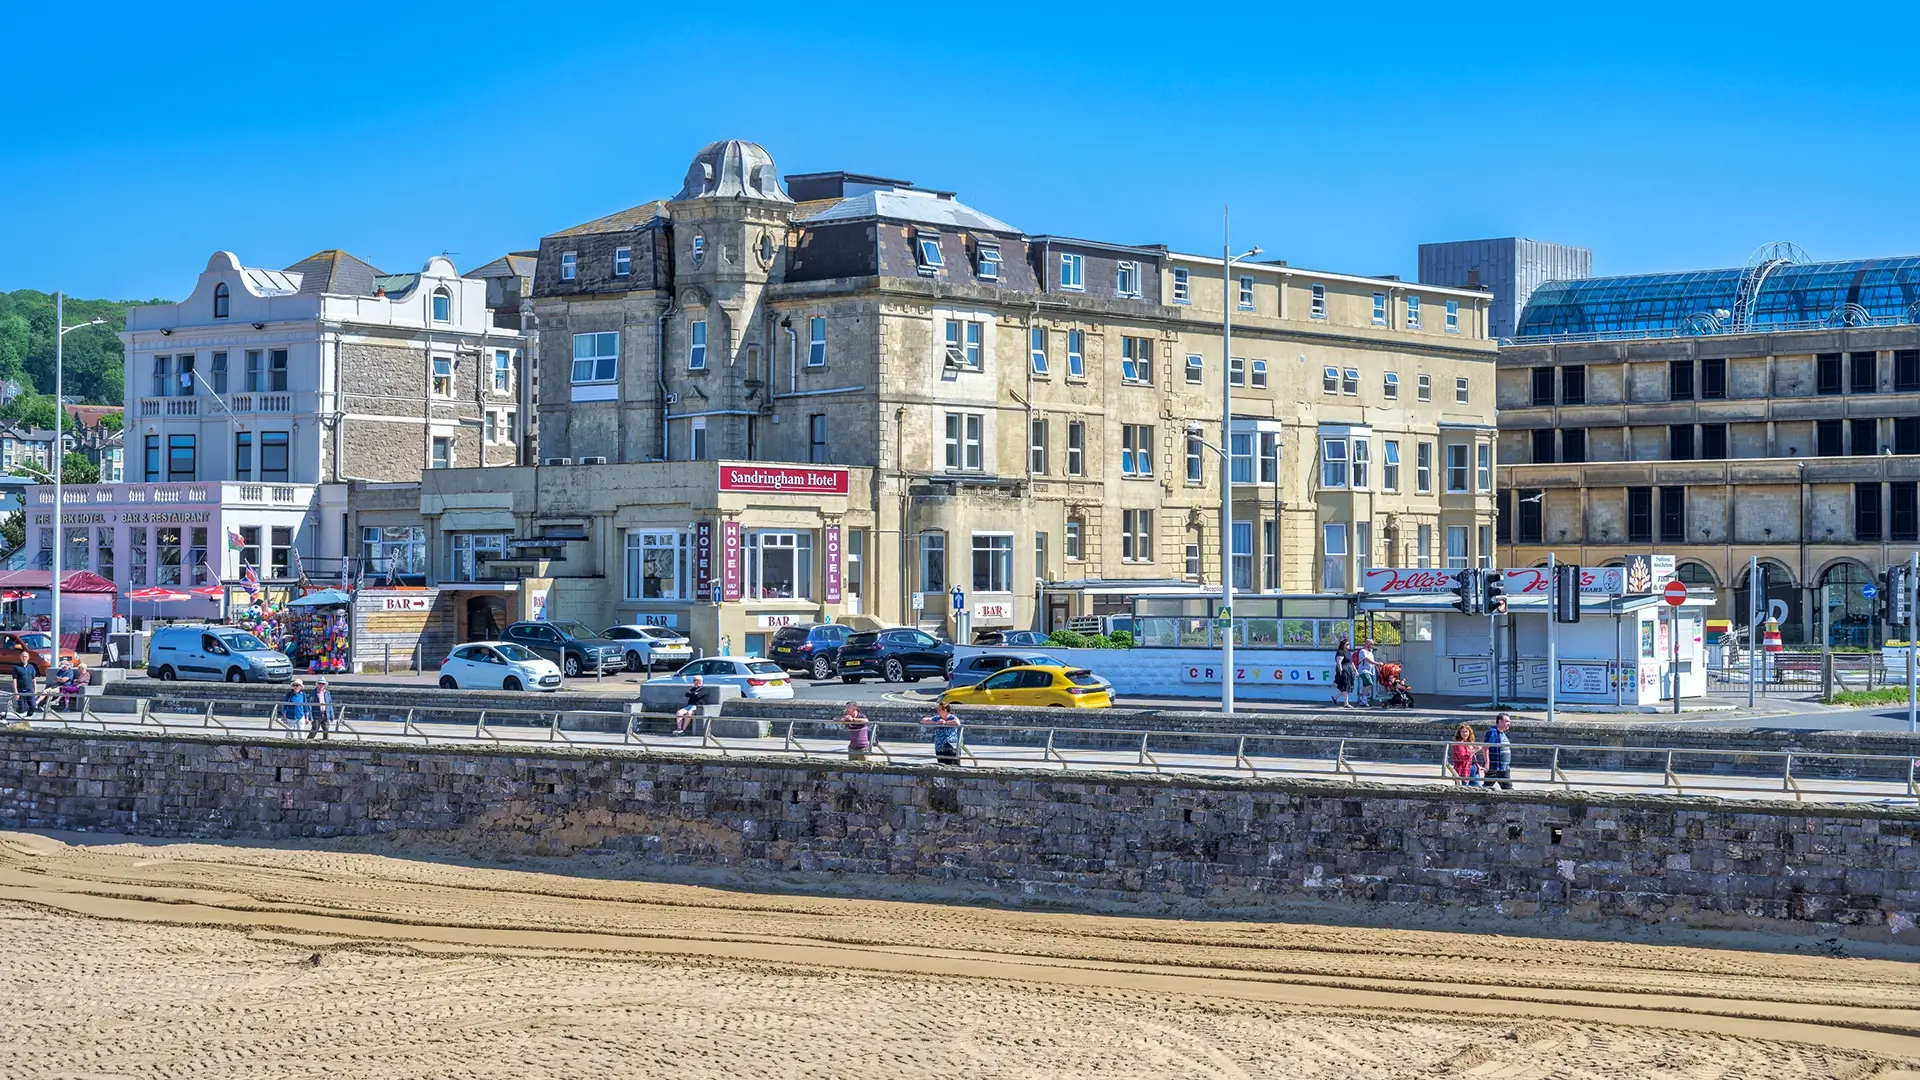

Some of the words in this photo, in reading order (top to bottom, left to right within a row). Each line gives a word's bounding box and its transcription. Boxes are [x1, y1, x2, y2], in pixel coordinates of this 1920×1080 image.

[731, 470, 804, 489] Sandringham
[807, 473, 837, 486] Hotel
[78, 513, 106, 524] HOTEL
[121, 513, 140, 523] BAR
[142, 513, 149, 523] &
[151, 512, 211, 523] RESTAURANT
[700, 526, 709, 579] HOTEL
[726, 526, 737, 579] HOTEL
[828, 532, 838, 583] HOTEL
[1203, 585, 1224, 593] Receptio
[387, 599, 411, 610] BAR
[533, 596, 545, 608] BAR
[982, 605, 1003, 617] BAR
[646, 615, 668, 627] BAR
[768, 616, 790, 627] BAR
[1189, 668, 1260, 680] CRZY
[1273, 669, 1330, 681] GOLF
